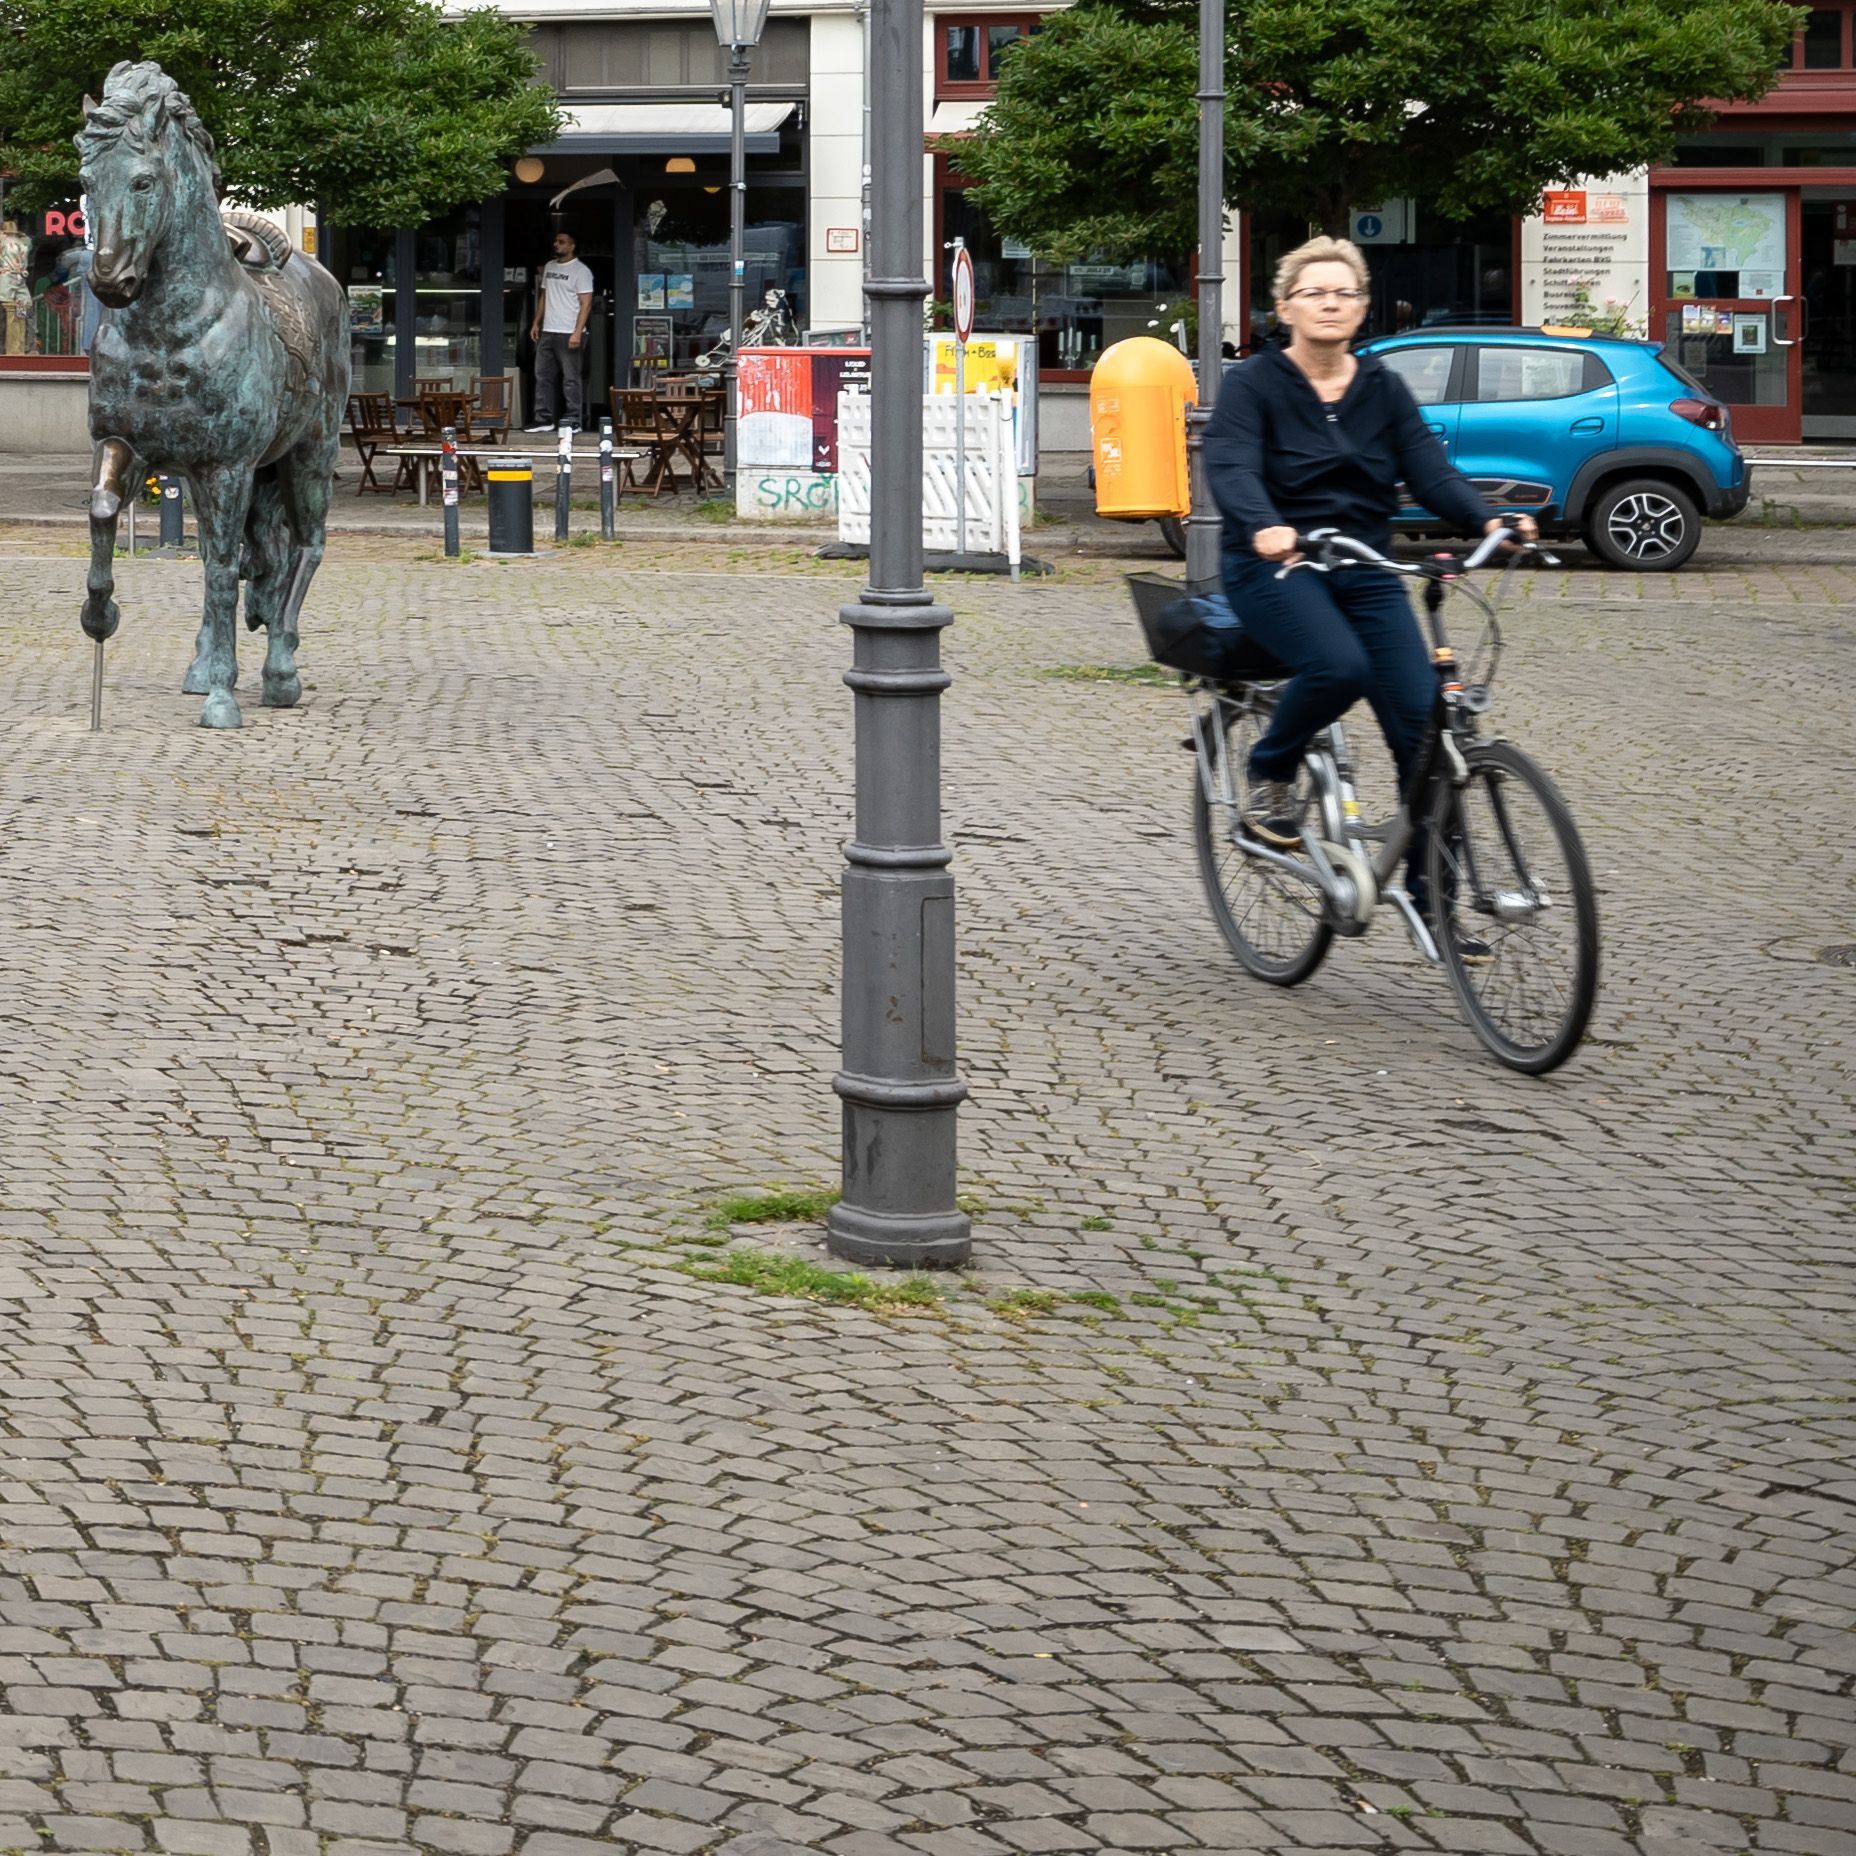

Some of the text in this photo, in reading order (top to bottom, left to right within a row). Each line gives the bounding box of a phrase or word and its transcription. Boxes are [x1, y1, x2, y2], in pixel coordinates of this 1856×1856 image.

[1543, 233, 1627, 241] Zimmervermittlung
[1543, 245, 1614, 253] Veranstaltungen
[1543, 267, 1611, 276] Stadtführungen
